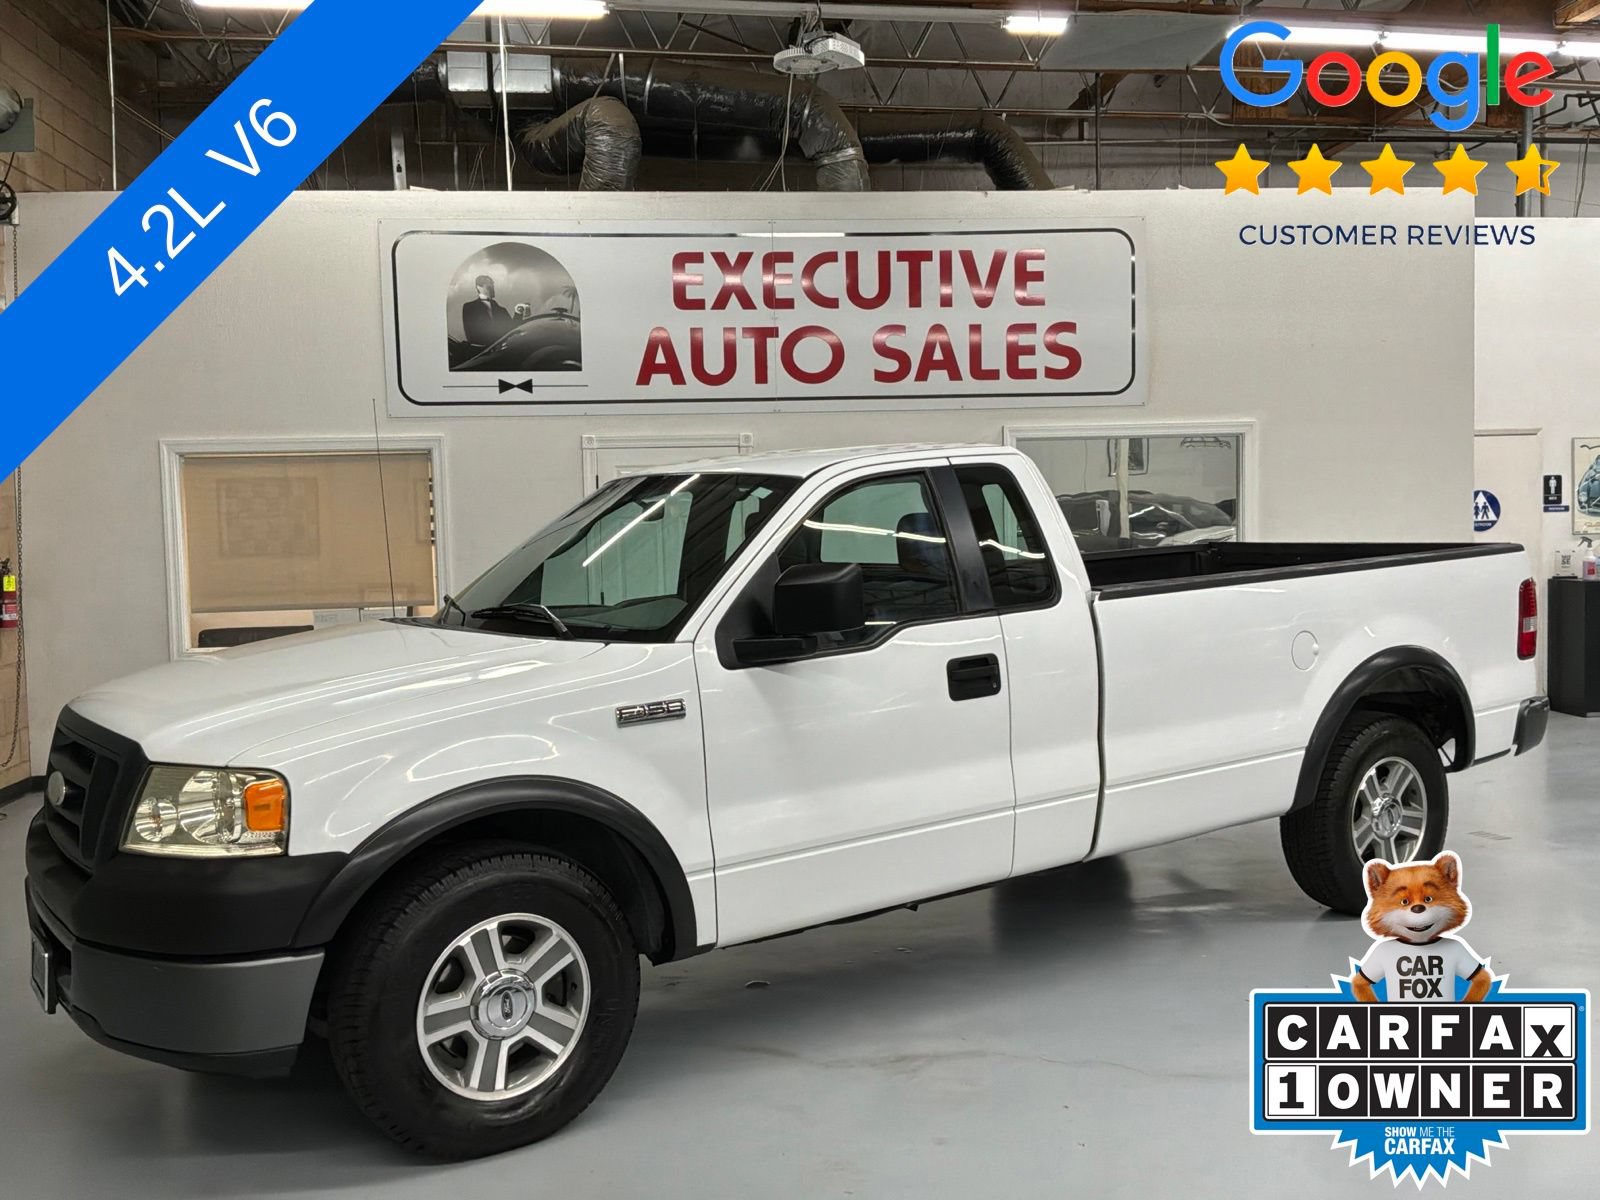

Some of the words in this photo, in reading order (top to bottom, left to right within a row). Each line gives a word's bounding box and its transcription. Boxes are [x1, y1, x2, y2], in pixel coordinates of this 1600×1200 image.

[671, 248, 1046, 311] EXECUTIVE
[635, 324, 845, 387] AUTO
[872, 321, 1082, 384] SALES
